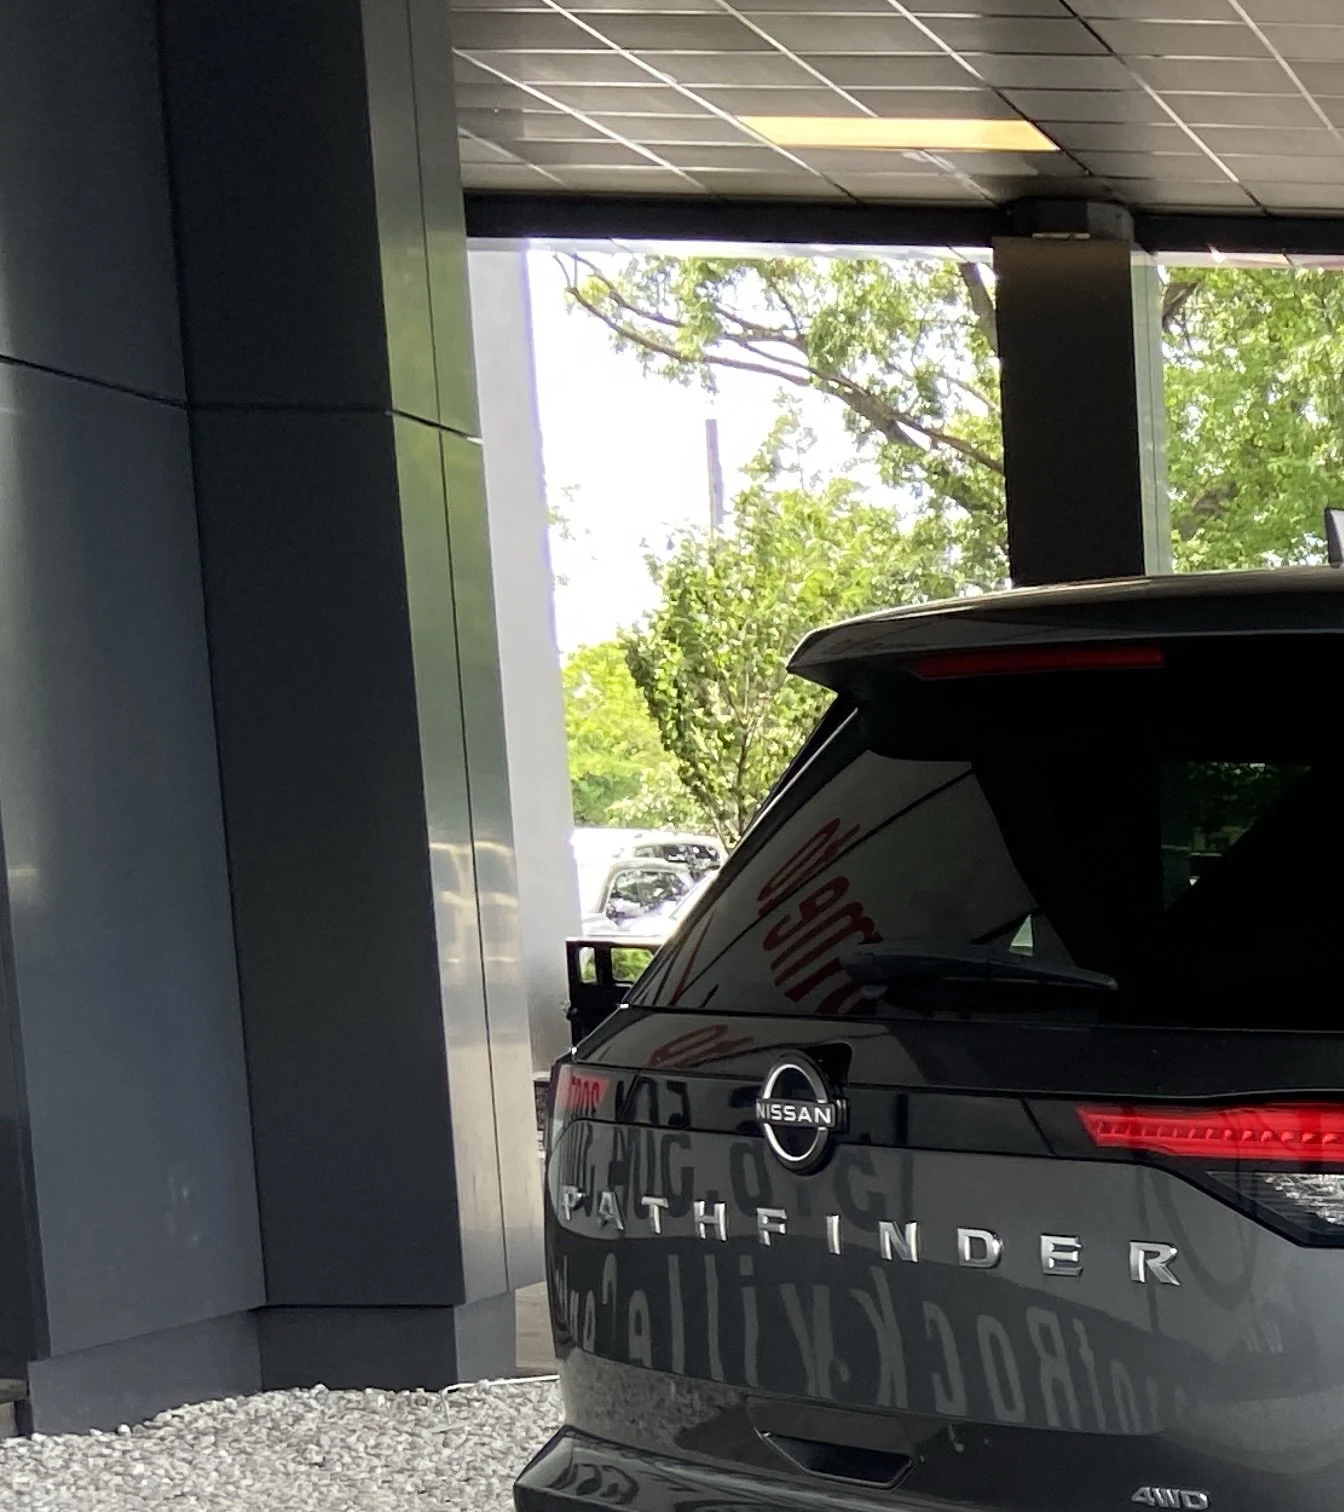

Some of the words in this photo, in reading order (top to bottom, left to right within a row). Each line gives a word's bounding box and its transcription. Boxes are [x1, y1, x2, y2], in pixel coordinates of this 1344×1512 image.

[755, 1101, 832, 1126] NISSAN
[562, 1184, 1181, 1288] PATHFINDER
[1130, 1486, 1211, 1511] 4WD
